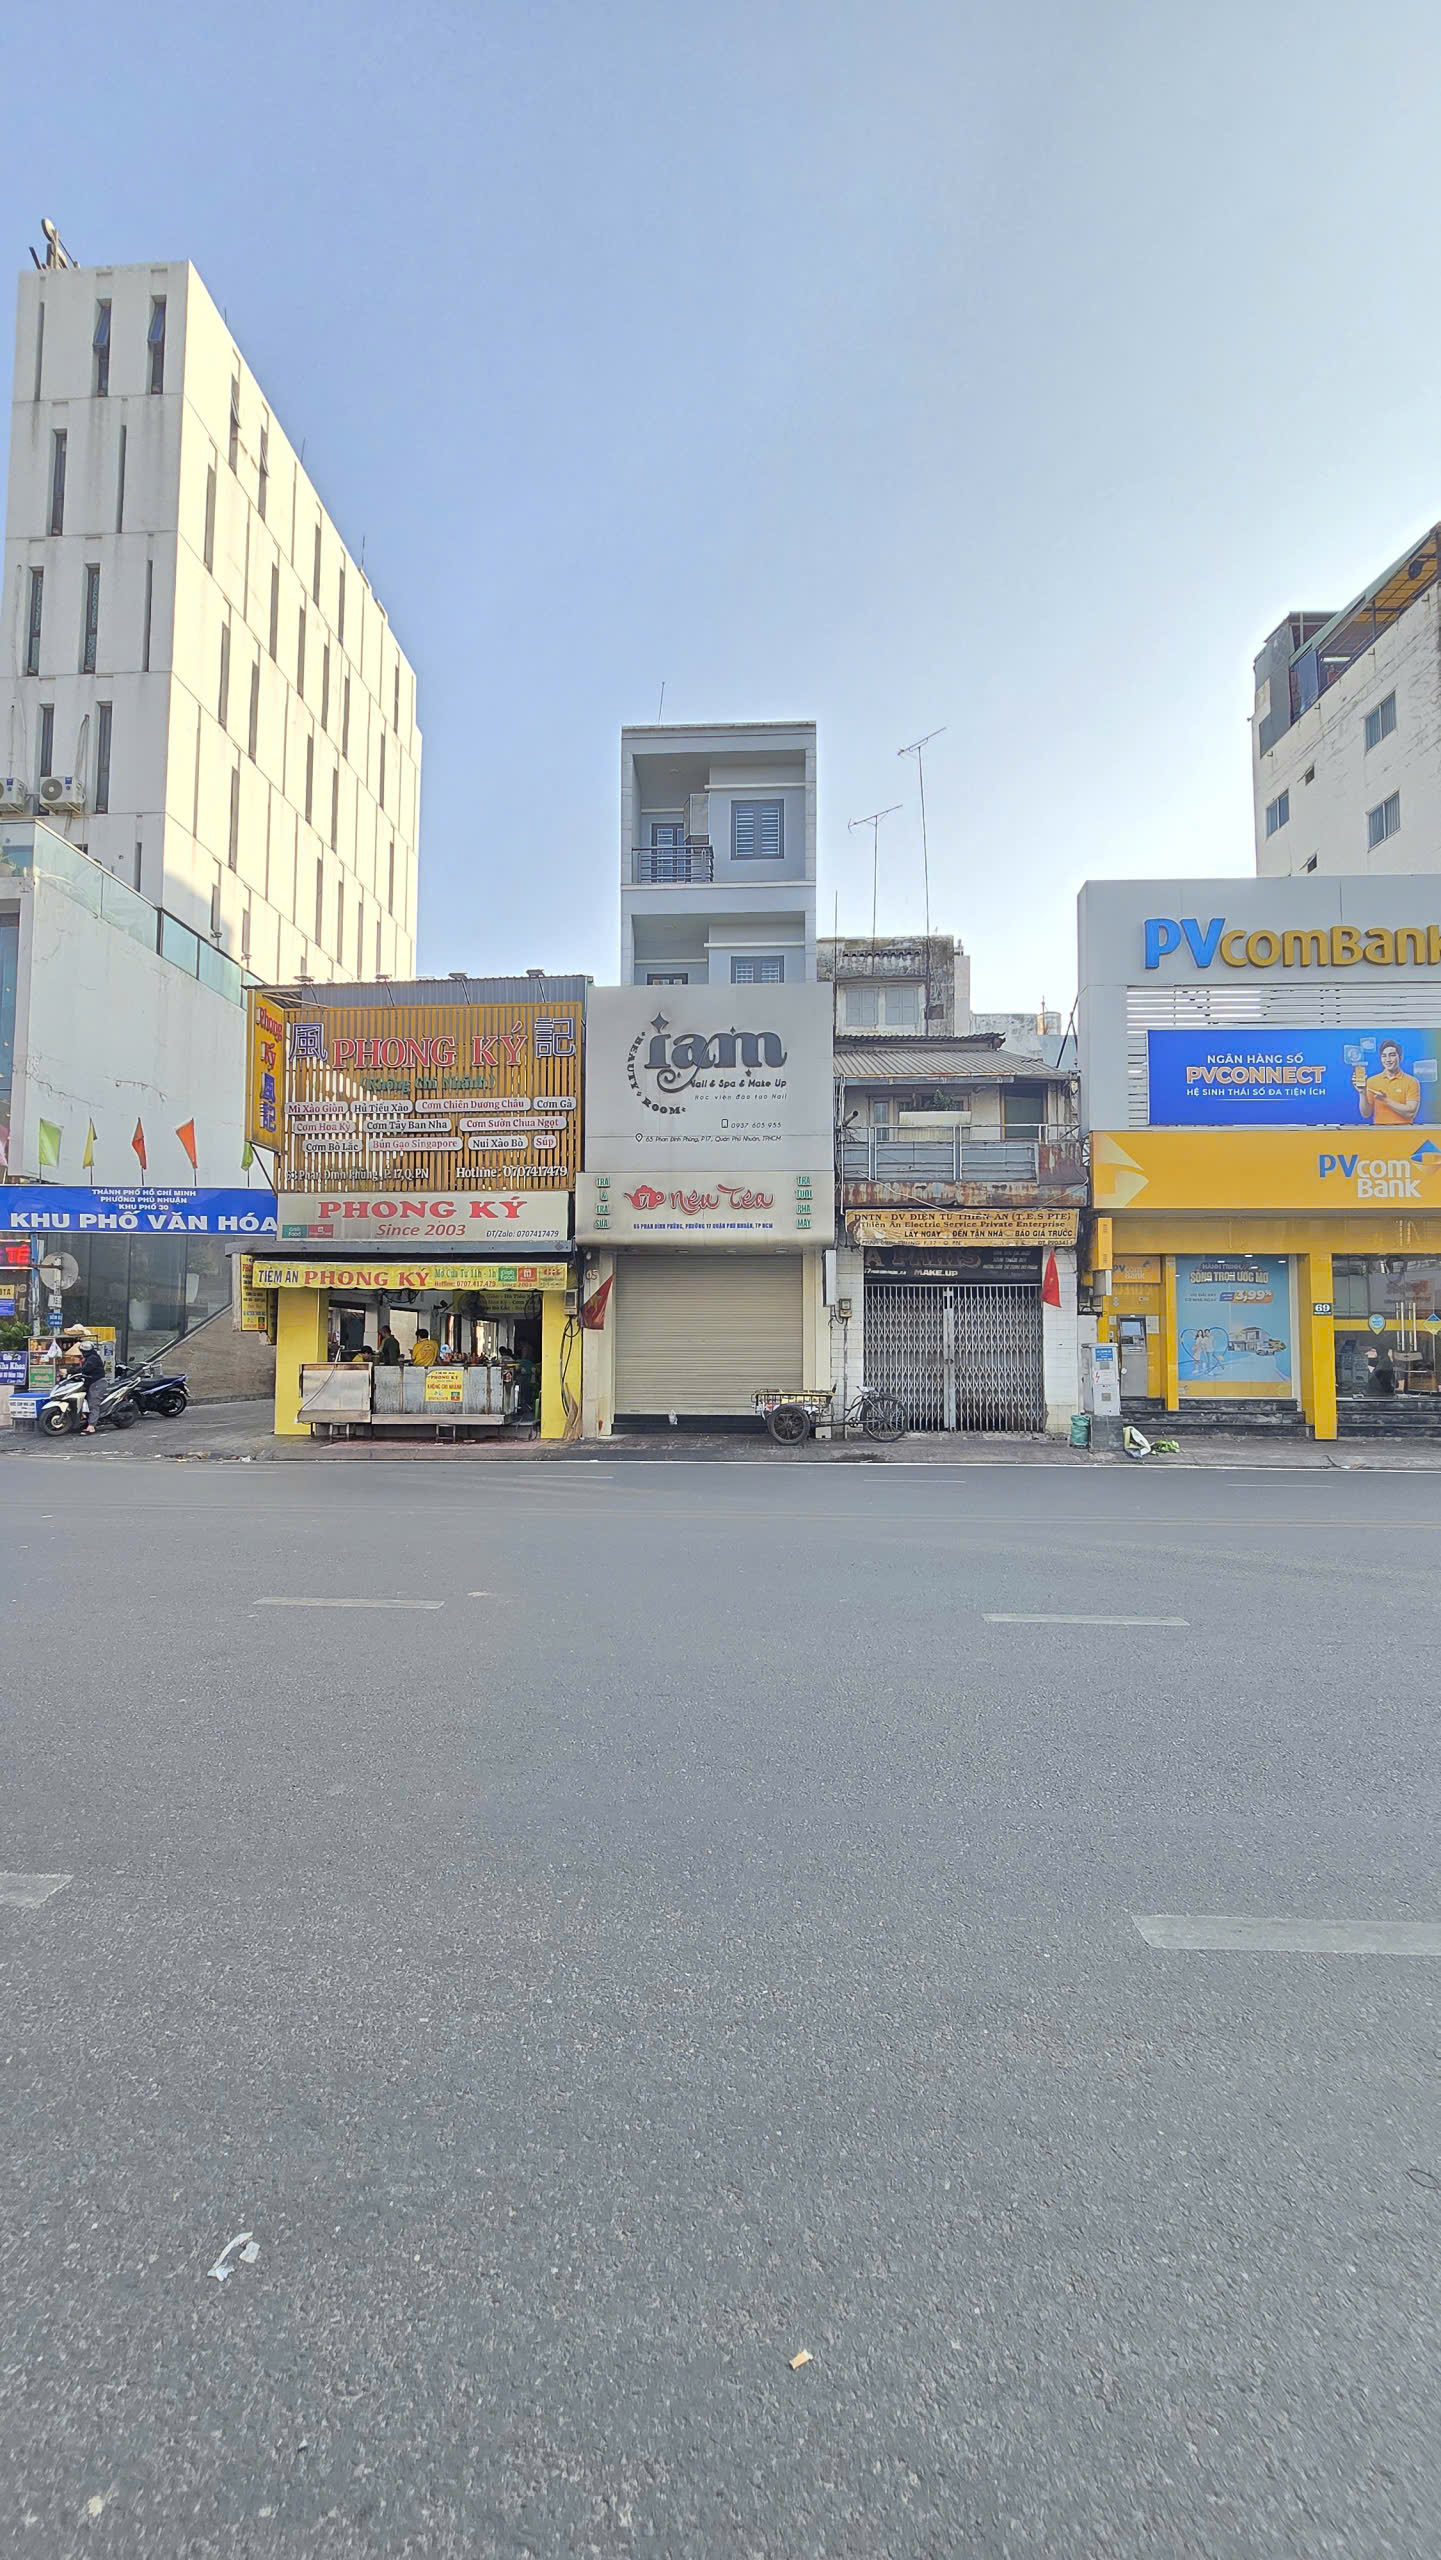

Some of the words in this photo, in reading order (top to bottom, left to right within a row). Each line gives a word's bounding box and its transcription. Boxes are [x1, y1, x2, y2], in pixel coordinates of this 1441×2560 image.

[256, 1007, 283, 1042] Phong
[288, 1022, 329, 1062] 風
[534, 1017, 576, 1058] 記
[332, 1036, 457, 1069] PHONG
[471, 1020, 528, 1067] KÝ
[261, 1041, 277, 1070] Ký
[1207, 1053, 1243, 1064] NGÂN
[1247, 1053, 1283, 1064] HÀNG
[1286, 1052, 1304, 1064] SỐ
[1186, 1066, 1326, 1084] PVCONNECT
[690, 1079, 708, 1088] Nail
[709, 1079, 715, 1088] &
[718, 1079, 736, 1089] Spa
[738, 1079, 745, 1088] &
[748, 1079, 771, 1088] Make
[775, 1079, 787, 1089] Up
[1186, 1088, 1200, 1096] HỆ
[1202, 1088, 1225, 1096] SINH
[1228, 1088, 1250, 1096] THÁI
[1252, 1087, 1266, 1096] SỐ
[1268, 1088, 1283, 1096] ĐA
[1285, 1087, 1306, 1097] TIỆN
[1309, 1087, 1326, 1096] ÍCH
[288, 1103, 301, 1113] Mì
[303, 1102, 321, 1113] Xào
[322, 1102, 344, 1113] Giòn
[354, 1102, 367, 1113] Hủ
[369, 1102, 389, 1112] Tiếu
[391, 1102, 409, 1112] Xào
[422, 1101, 442, 1110] Cơm
[443, 1100, 469, 1110] Chiên
[470, 1099, 500, 1110] Dương
[501, 1098, 524, 1108] Châu
[537, 1099, 558, 1109] Cơm
[560, 1098, 573, 1109] Gà
[641, 1097, 681, 1115] ROOM
[296, 1122, 317, 1131] Cơm
[319, 1122, 337, 1131] Hoa
[366, 1121, 387, 1130] Cơm
[389, 1119, 406, 1131] Tây
[408, 1119, 427, 1129] Ban
[428, 1119, 448, 1129] Nha
[466, 1119, 486, 1128] Cơm
[488, 1117, 511, 1128] Sườn
[513, 1117, 536, 1127] Chua
[537, 1117, 559, 1129] Ngọt
[306, 1143, 327, 1152] Cơm
[328, 1141, 341, 1151] Bò
[372, 1139, 391, 1149] Bún
[392, 1139, 410, 1150] Gạo
[411, 1138, 458, 1150] Singapore
[472, 1139, 489, 1148] Nui
[490, 1138, 509, 1148] Xào
[511, 1137, 524, 1147] Bò
[535, 1137, 554, 1149] Súp
[503, 1165, 568, 1178] 0707417479
[1318, 1153, 1411, 1178] PVcom
[1357, 1178, 1422, 1198] Bank
[318, 1200, 457, 1219] PHONG
[468, 1196, 528, 1219] KÝ
[10, 1212, 70, 1228] KHU
[79, 1210, 141, 1229] PHỐ
[147, 1211, 208, 1231] VĂN
[217, 1212, 277, 1231] HÓA
[1016, 1221, 1065, 1229] Enterprise
[375, 1223, 420, 1236] Since
[423, 1224, 466, 1236] 2003
[486, 1230, 516, 1239] ĐT/Zalo:
[516, 1230, 560, 1238] 0707417479
[919, 1230, 941, 1238] NGAY
[258, 1266, 283, 1286] TIỆM
[284, 1267, 299, 1283] ĂN
[303, 1271, 389, 1286] PHONG
[398, 1267, 429, 1286] KÝ
[1314, 1303, 1331, 1312] 69
